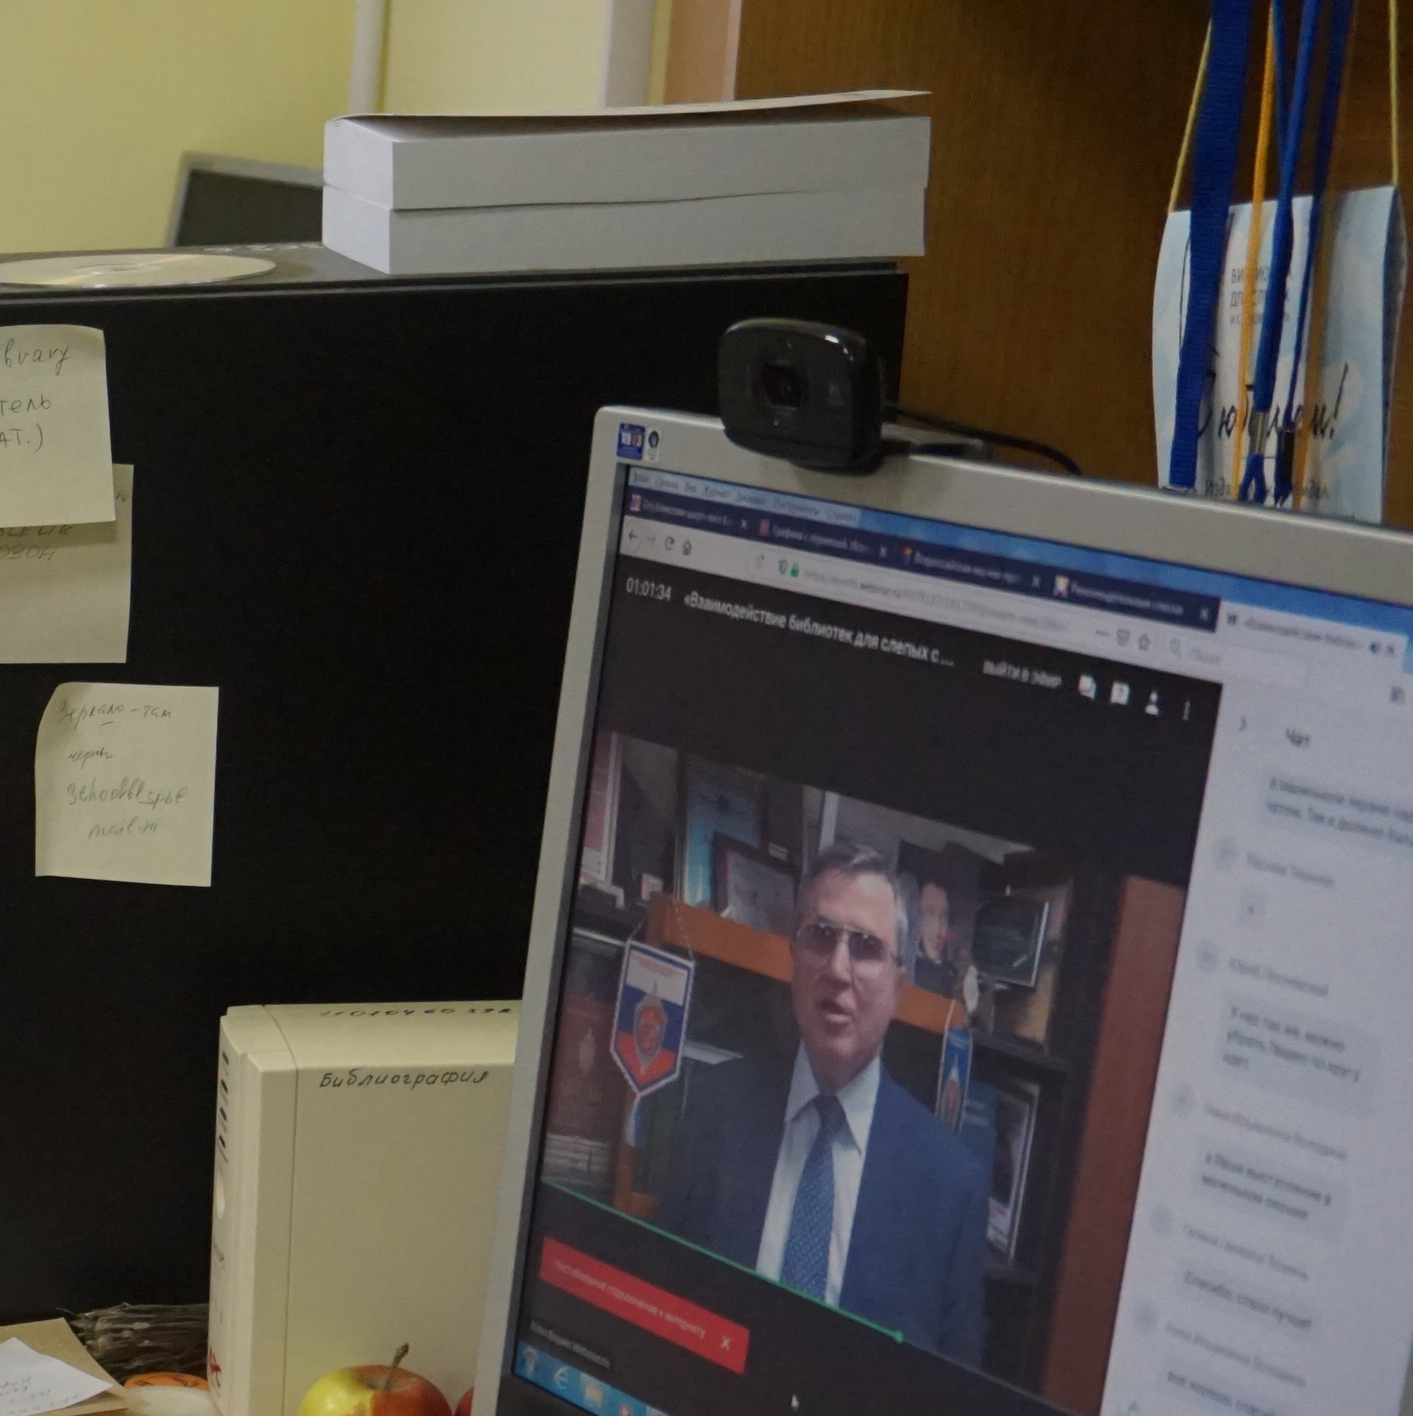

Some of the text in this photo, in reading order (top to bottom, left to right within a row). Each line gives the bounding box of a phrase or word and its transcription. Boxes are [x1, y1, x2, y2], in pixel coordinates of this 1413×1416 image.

[626, 577, 671, 602] 01:01:34
[788, 614, 854, 644] библиотек
[854, 631, 879, 650] для
[881, 636, 930, 664] слепых
[320, 1071, 489, 1090] Библиография
